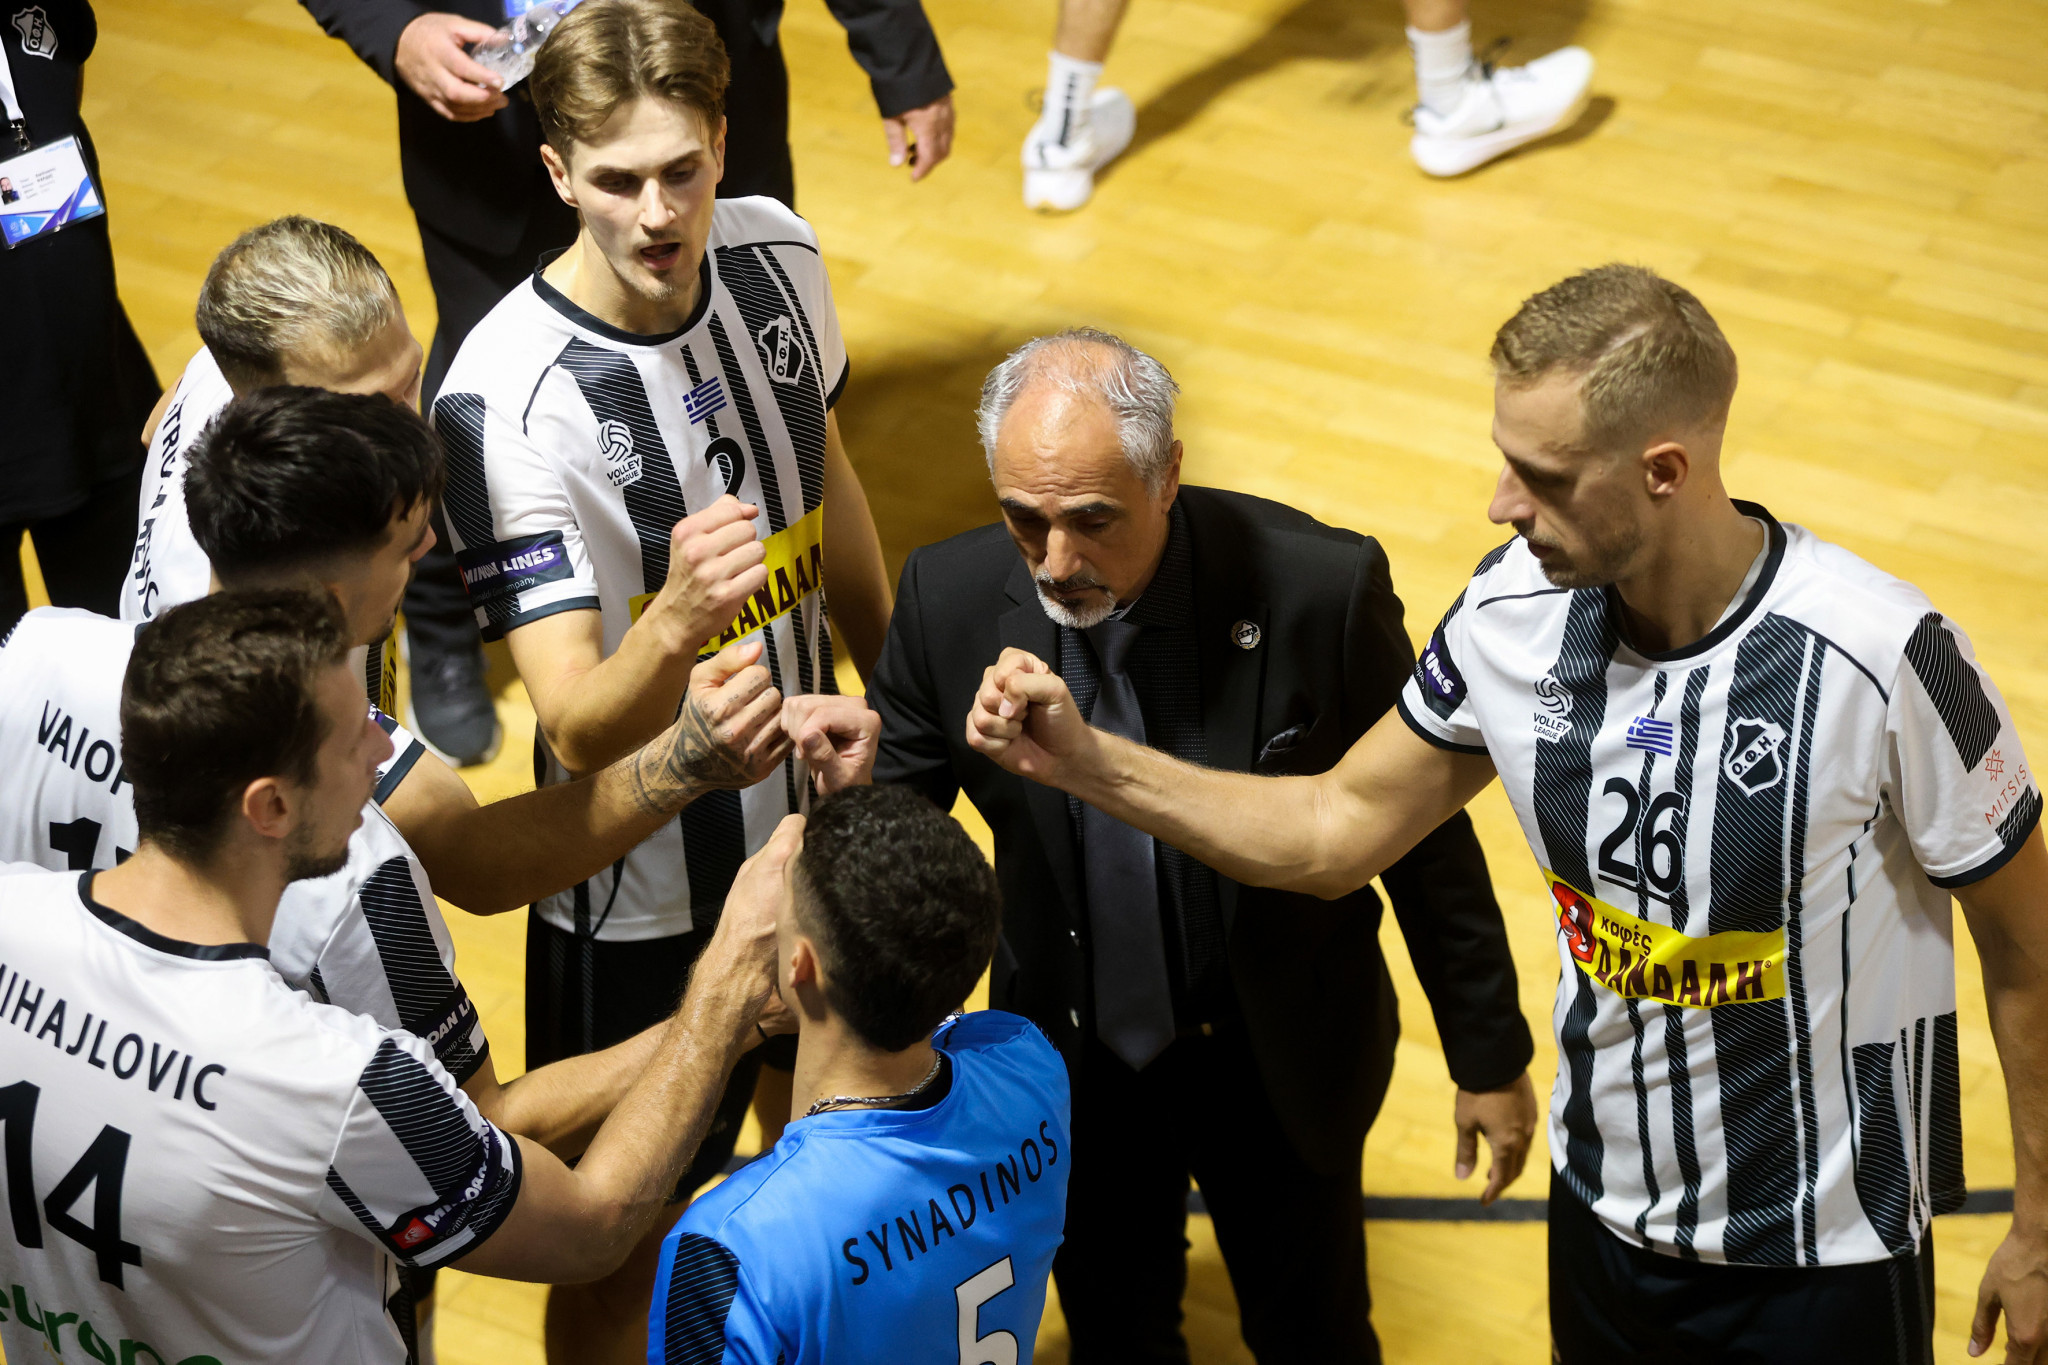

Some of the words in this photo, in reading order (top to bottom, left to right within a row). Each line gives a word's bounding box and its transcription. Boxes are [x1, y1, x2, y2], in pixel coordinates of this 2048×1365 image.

[606, 457, 641, 481] VOLLEY
[613, 470, 640, 488] LEAGUE
[502, 547, 556, 572] LINES
[1534, 712, 1569, 732] VOLLEY
[1534, 724, 1559, 740] LEAGUE
[1985, 764, 2027, 825] MITSIS
[49, 817, 134, 870] 1
[1598, 776, 1685, 894] 26
[0, 1080, 143, 1292] 14
[842, 1120, 1058, 1286] SYNADINOS
[954, 1254, 1020, 1365] 5
